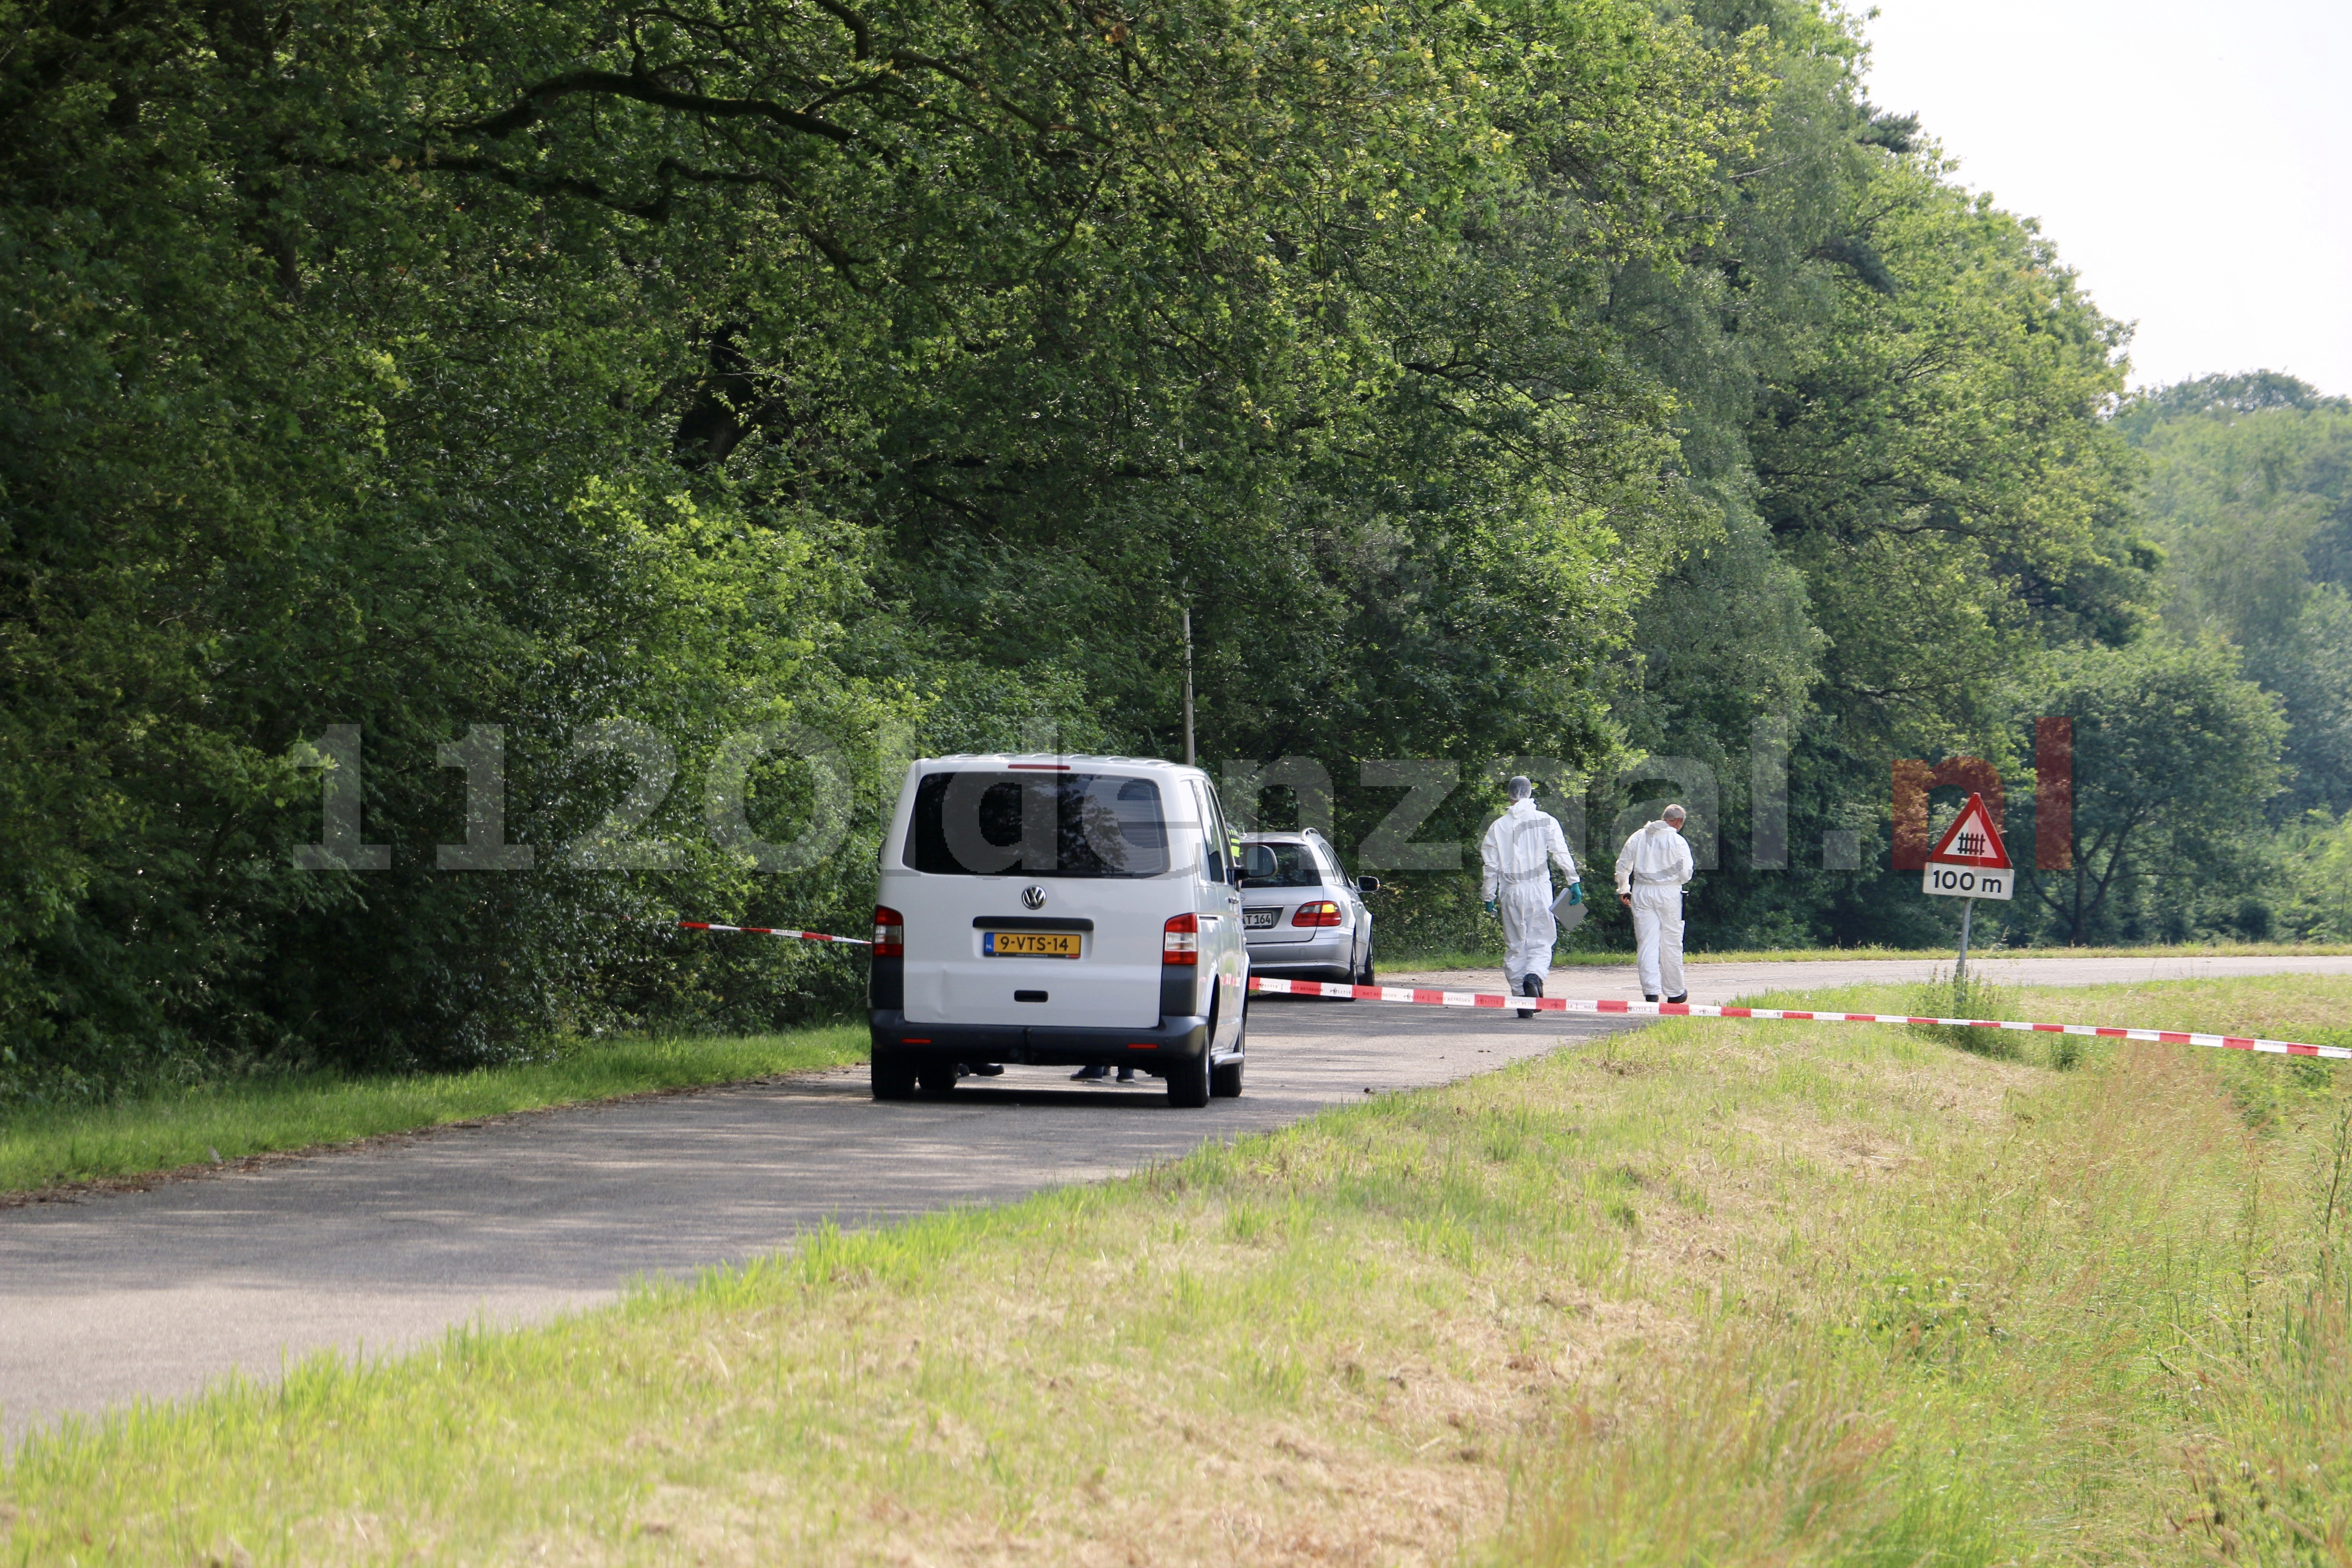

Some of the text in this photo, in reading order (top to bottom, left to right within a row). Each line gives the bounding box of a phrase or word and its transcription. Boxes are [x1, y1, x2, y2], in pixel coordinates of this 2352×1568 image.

[1933, 870, 2002, 893] 100 m
[1254, 915, 1271, 924] 164
[1000, 936, 1069, 951] 9-VTS-14
